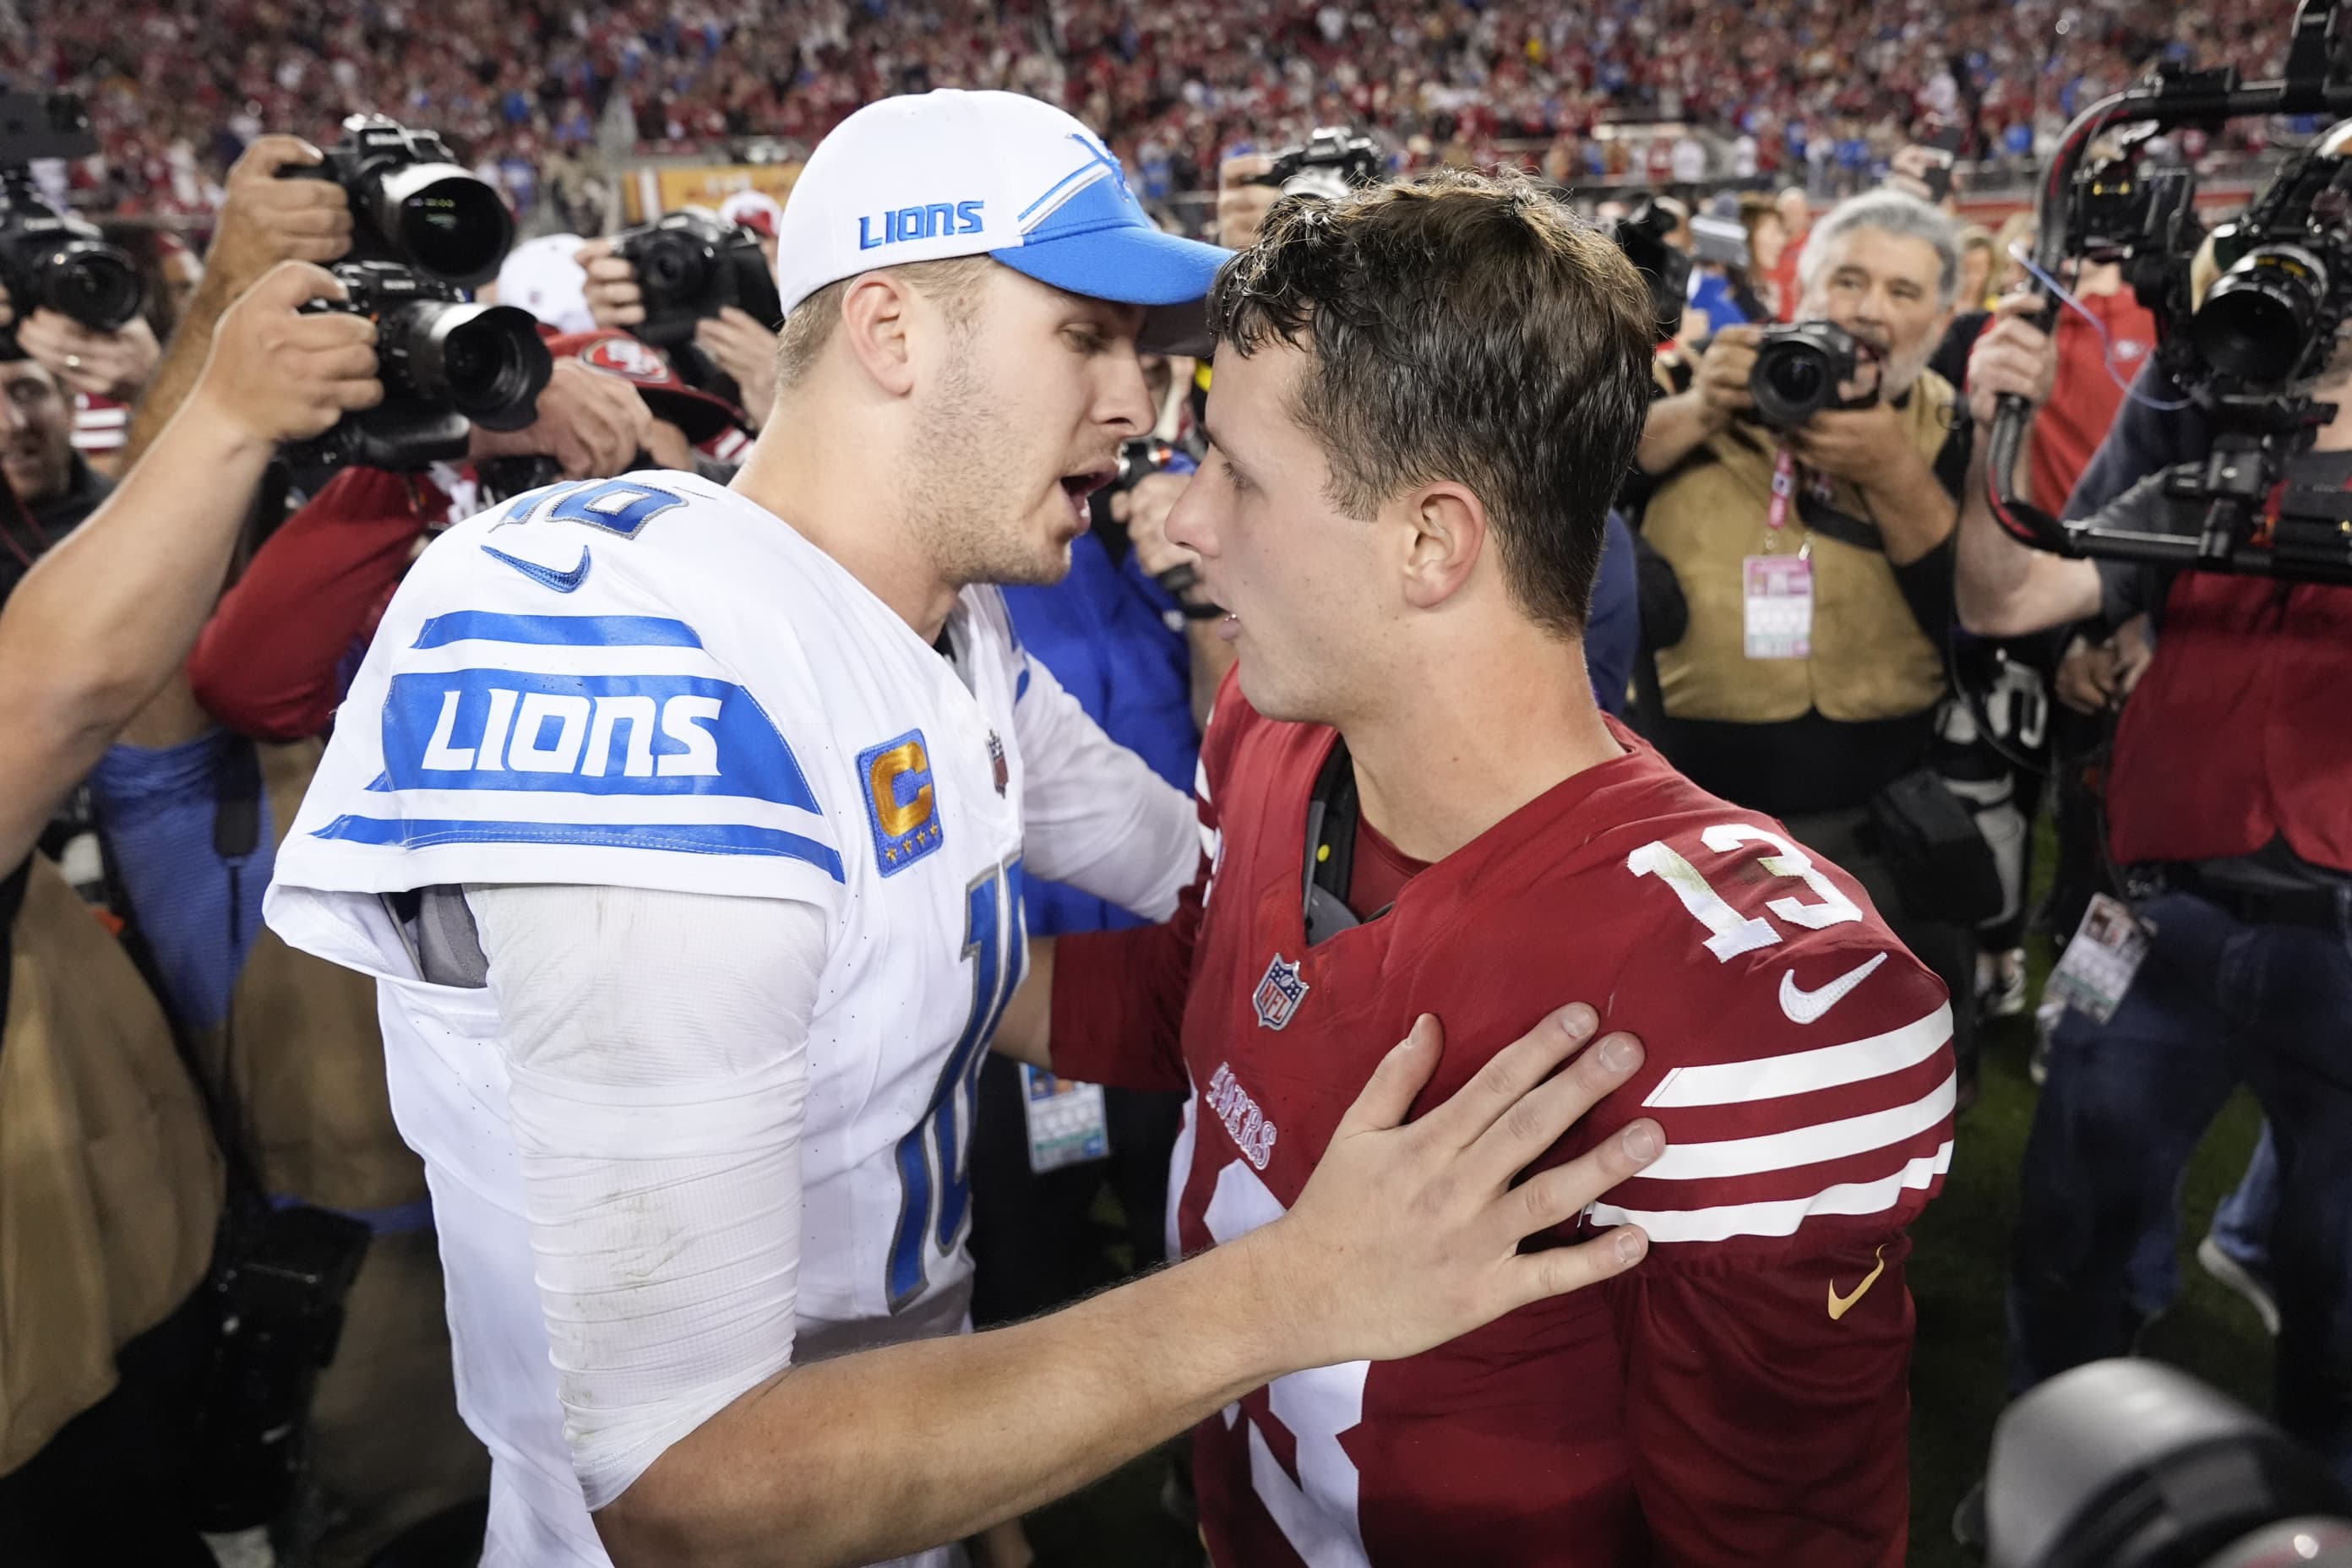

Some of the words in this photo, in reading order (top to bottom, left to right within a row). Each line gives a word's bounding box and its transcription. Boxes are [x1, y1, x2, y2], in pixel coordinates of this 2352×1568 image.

[858, 200, 984, 251] LIONS
[421, 688, 723, 777] LIONS
[870, 740, 934, 837] C
[1627, 823, 1864, 963] 13
